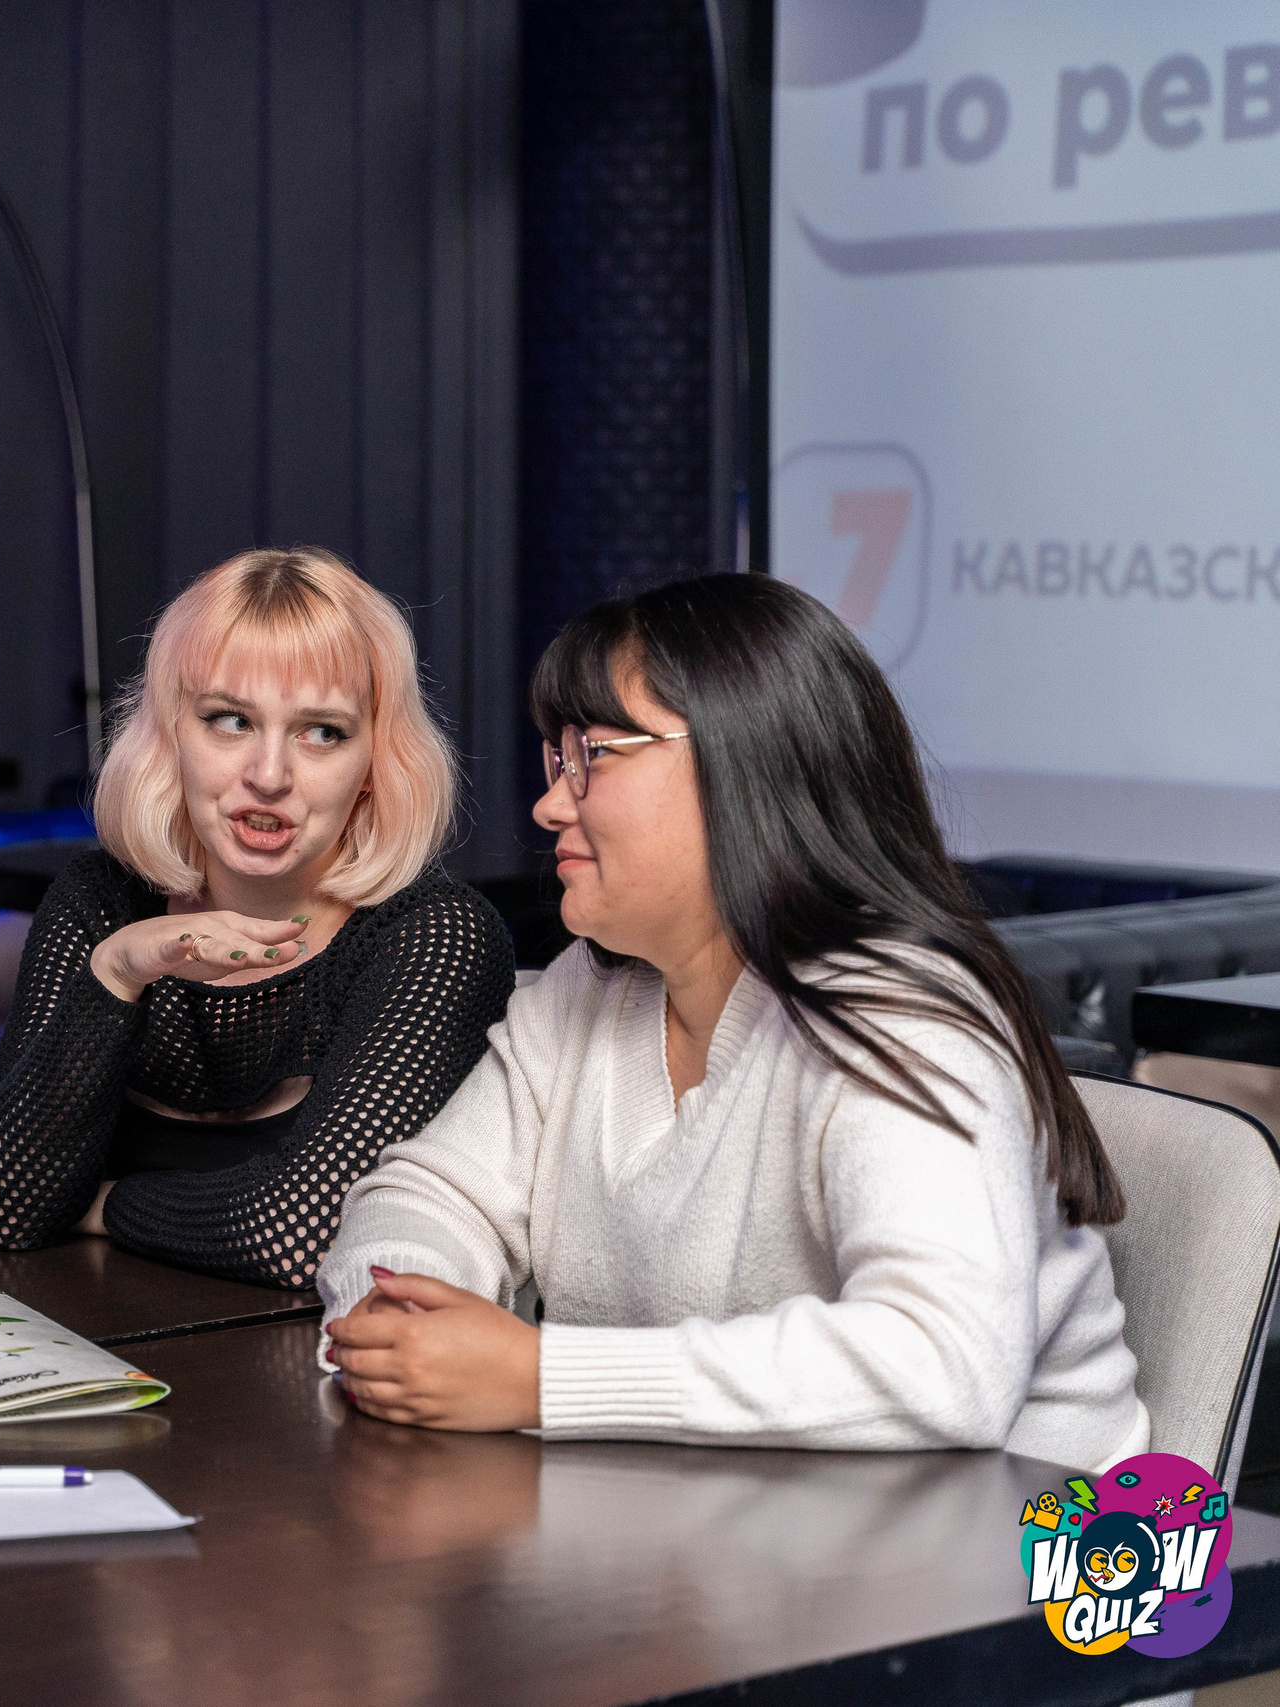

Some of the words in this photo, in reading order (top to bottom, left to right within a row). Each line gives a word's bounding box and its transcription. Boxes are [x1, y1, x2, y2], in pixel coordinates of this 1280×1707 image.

[860, 71, 1011, 173] по
[1052, 43, 1280, 190] рев
[950, 537, 1280, 604] КАВКАЗСК
